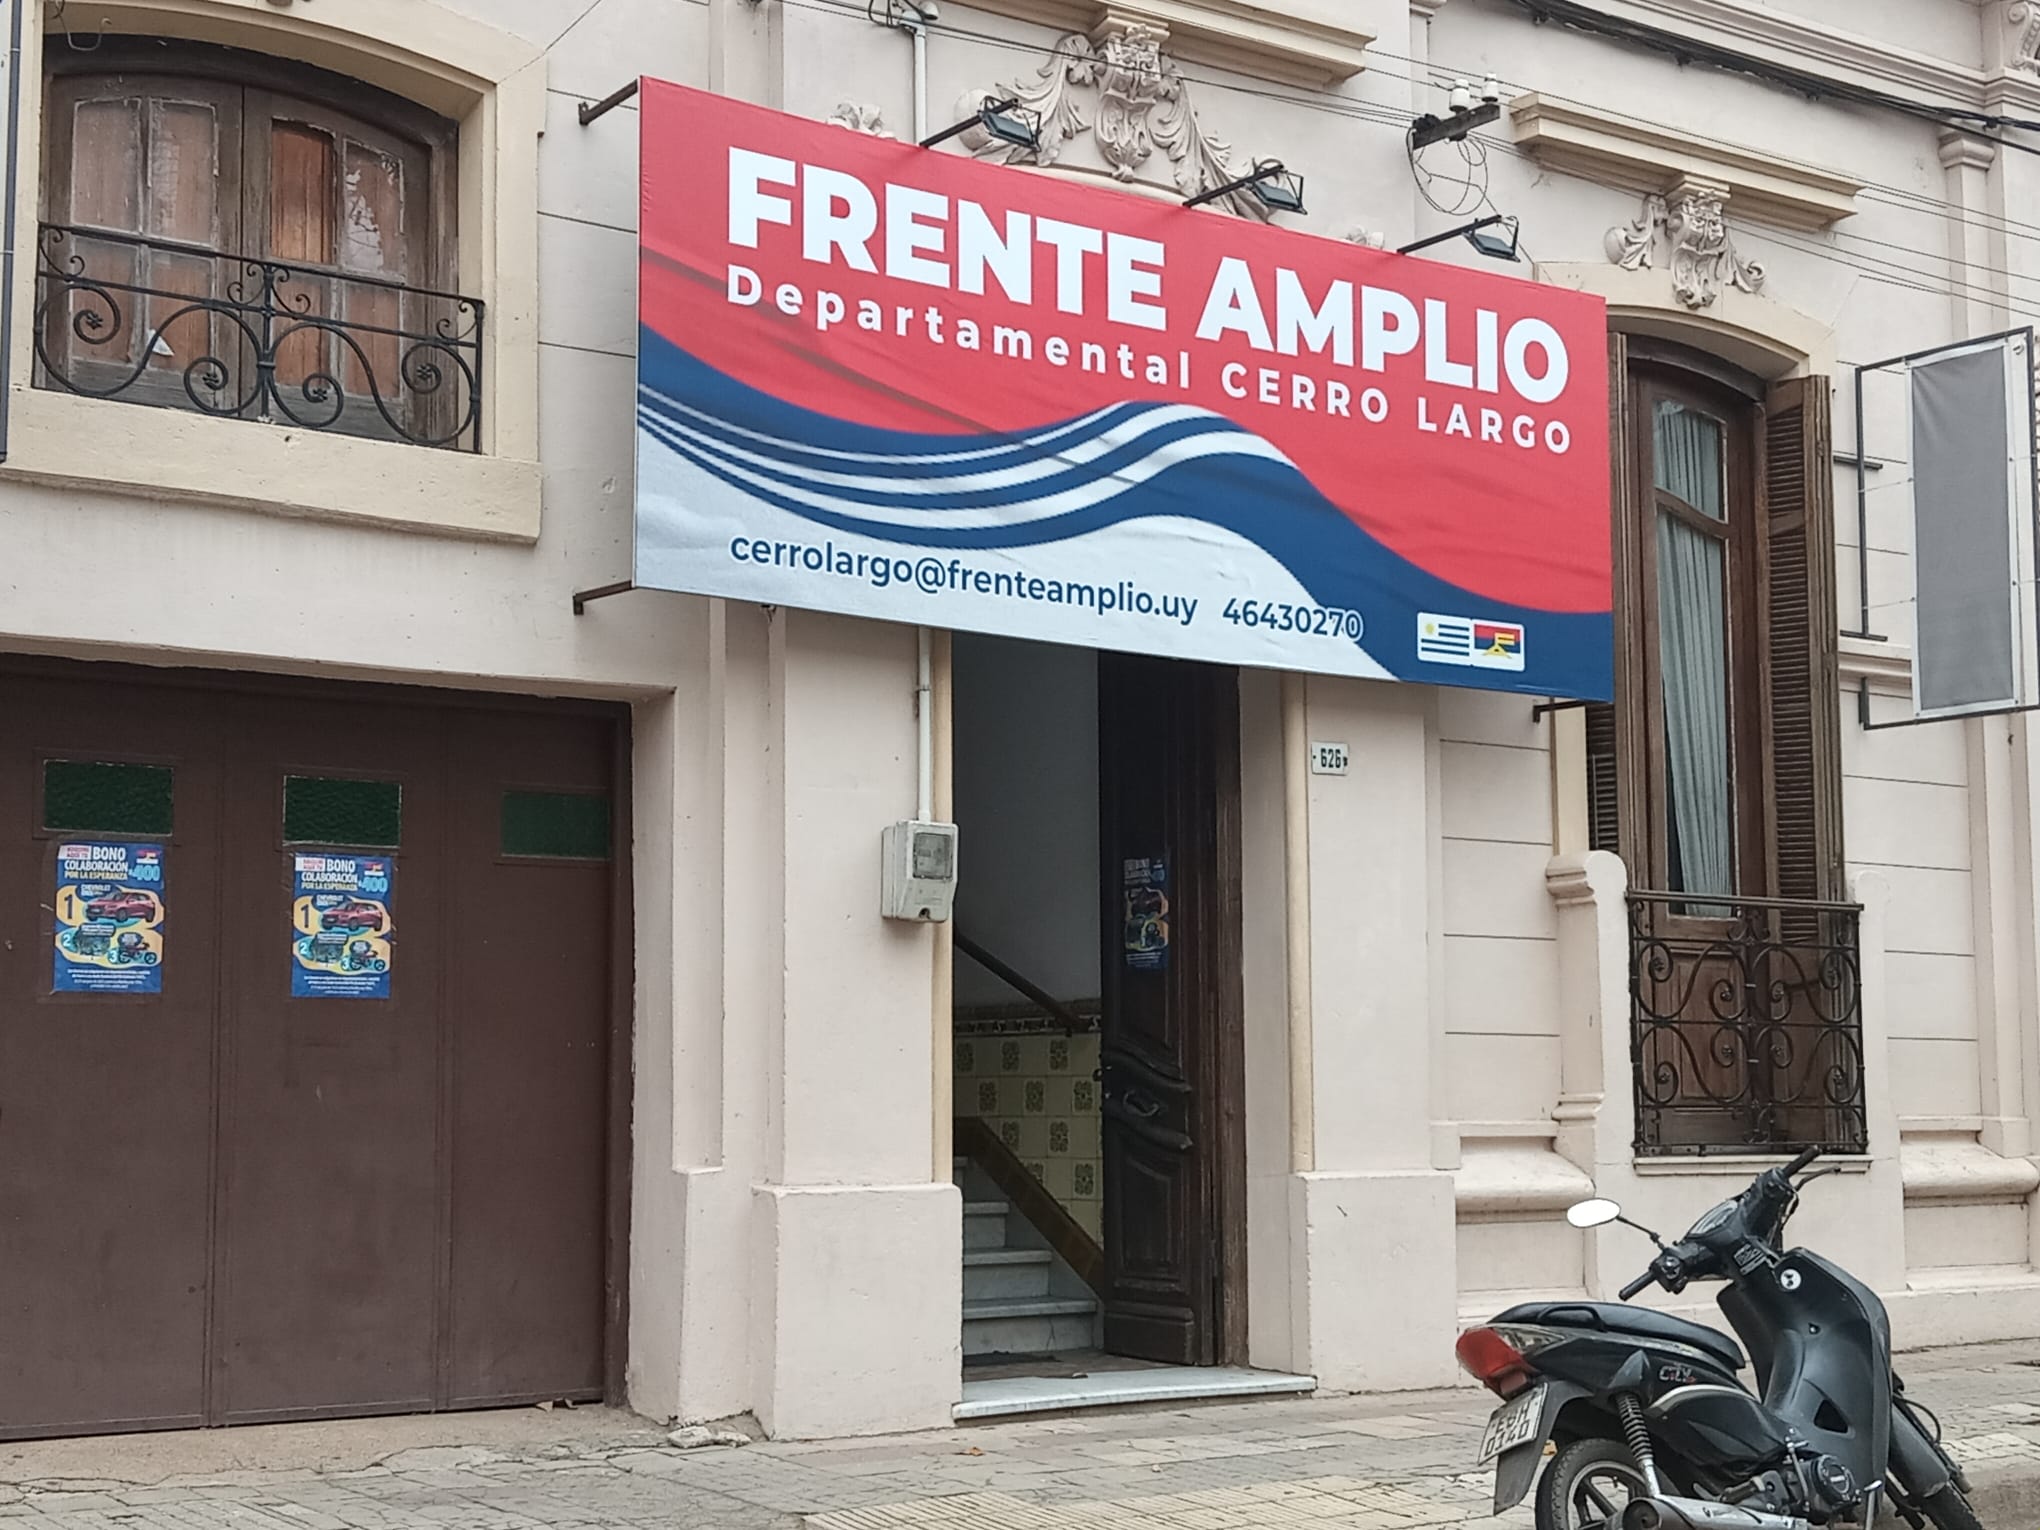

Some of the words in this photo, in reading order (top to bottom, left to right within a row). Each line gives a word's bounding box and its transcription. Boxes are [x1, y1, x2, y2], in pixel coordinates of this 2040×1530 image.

[728, 146, 1166, 331] FRENTE
[1195, 256, 1569, 403] AMPLIO
[728, 264, 1189, 389] Departamental
[1221, 362, 1389, 422] CERRO
[1417, 396, 1570, 455] LARGO
[730, 537, 1199, 627] cerrolargo@frenteamplio.uy
[1222, 598, 1363, 640] 46430270
[1320, 747, 1342, 769] 626
[92, 846, 126, 861] BONO
[326, 858, 356, 873] BONO
[64, 894, 73, 919] 1
[301, 903, 310, 929] 1
[62, 933, 71, 948] 2
[300, 942, 308, 955] 2
[109, 950, 118, 963] 3
